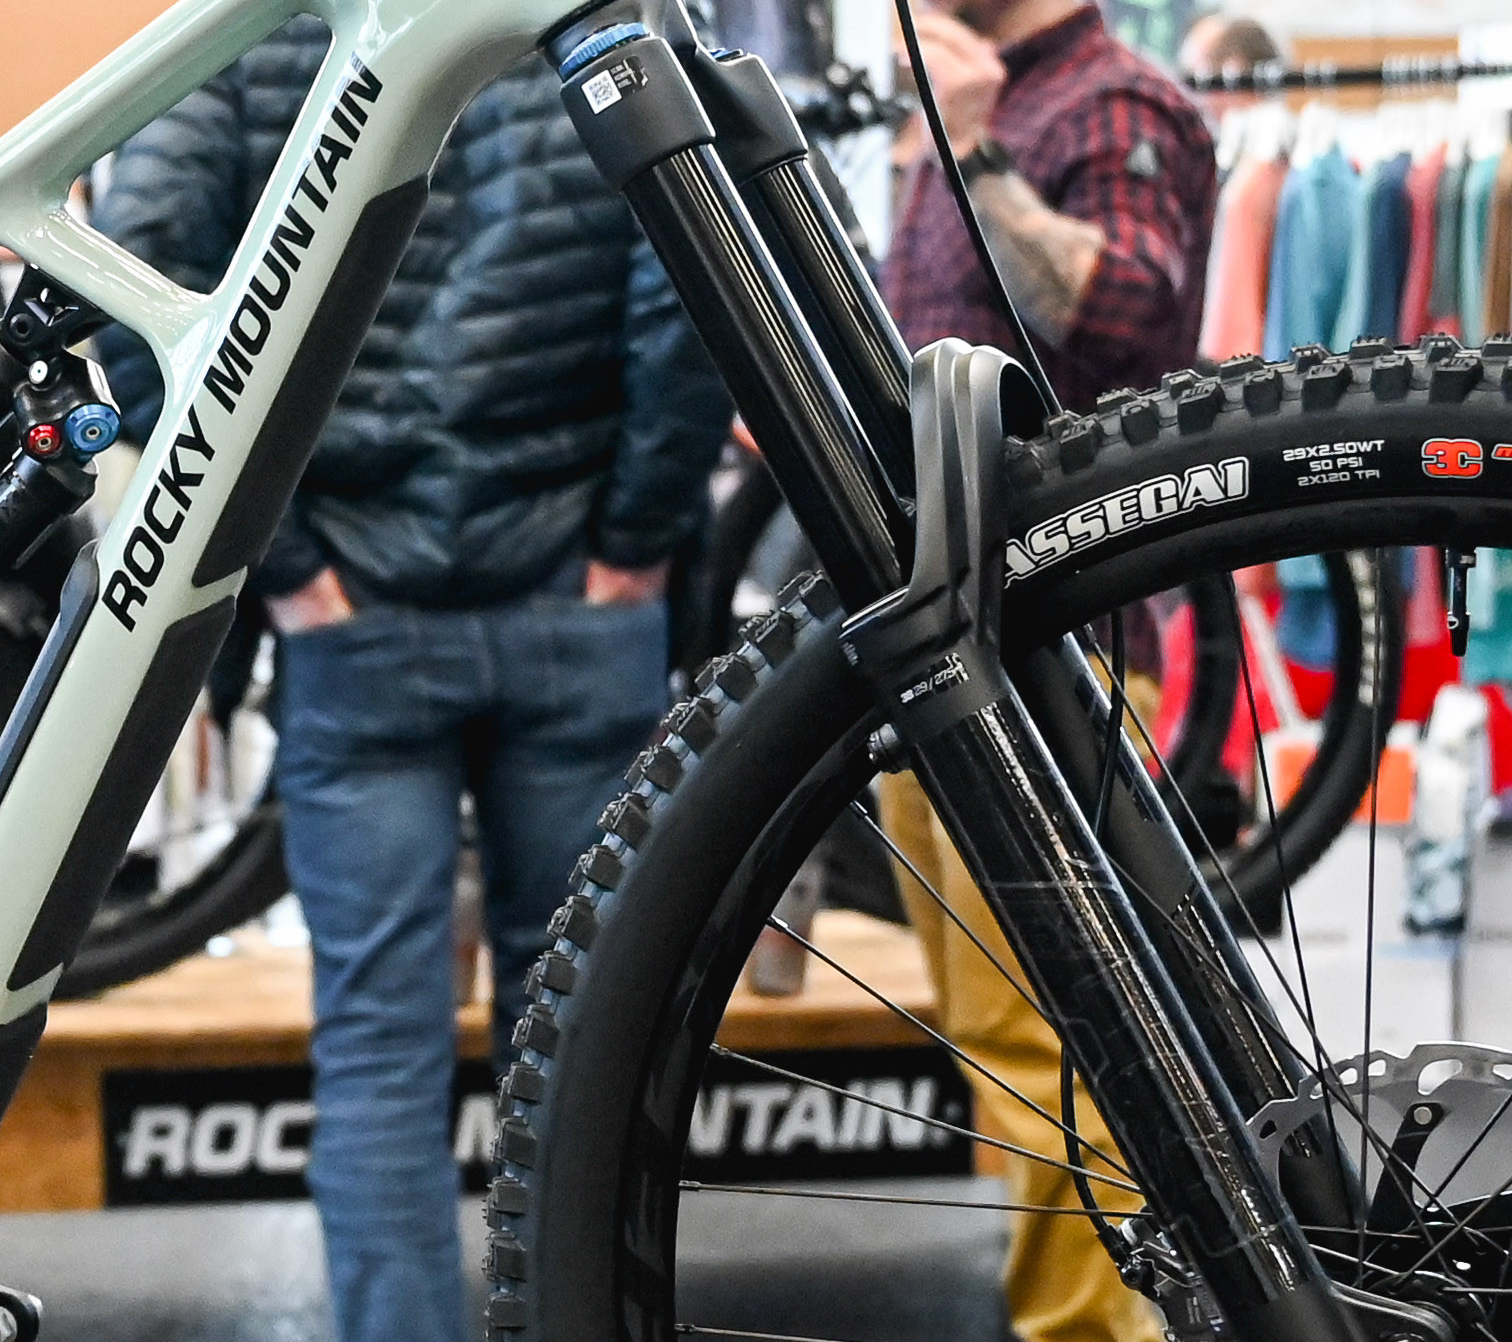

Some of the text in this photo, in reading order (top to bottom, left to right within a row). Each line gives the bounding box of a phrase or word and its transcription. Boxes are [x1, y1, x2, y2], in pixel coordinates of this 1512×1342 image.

[102, 51, 384, 633] ROCKY MOUNTAIN
[1282, 439, 1386, 462] 29X2.50WT
[1336, 457, 1363, 470] PSI
[1356, 469, 1381, 484] TPI
[1003, 455, 1249, 590] ASSEGAI
[123, 1101, 313, 1175] ROC
